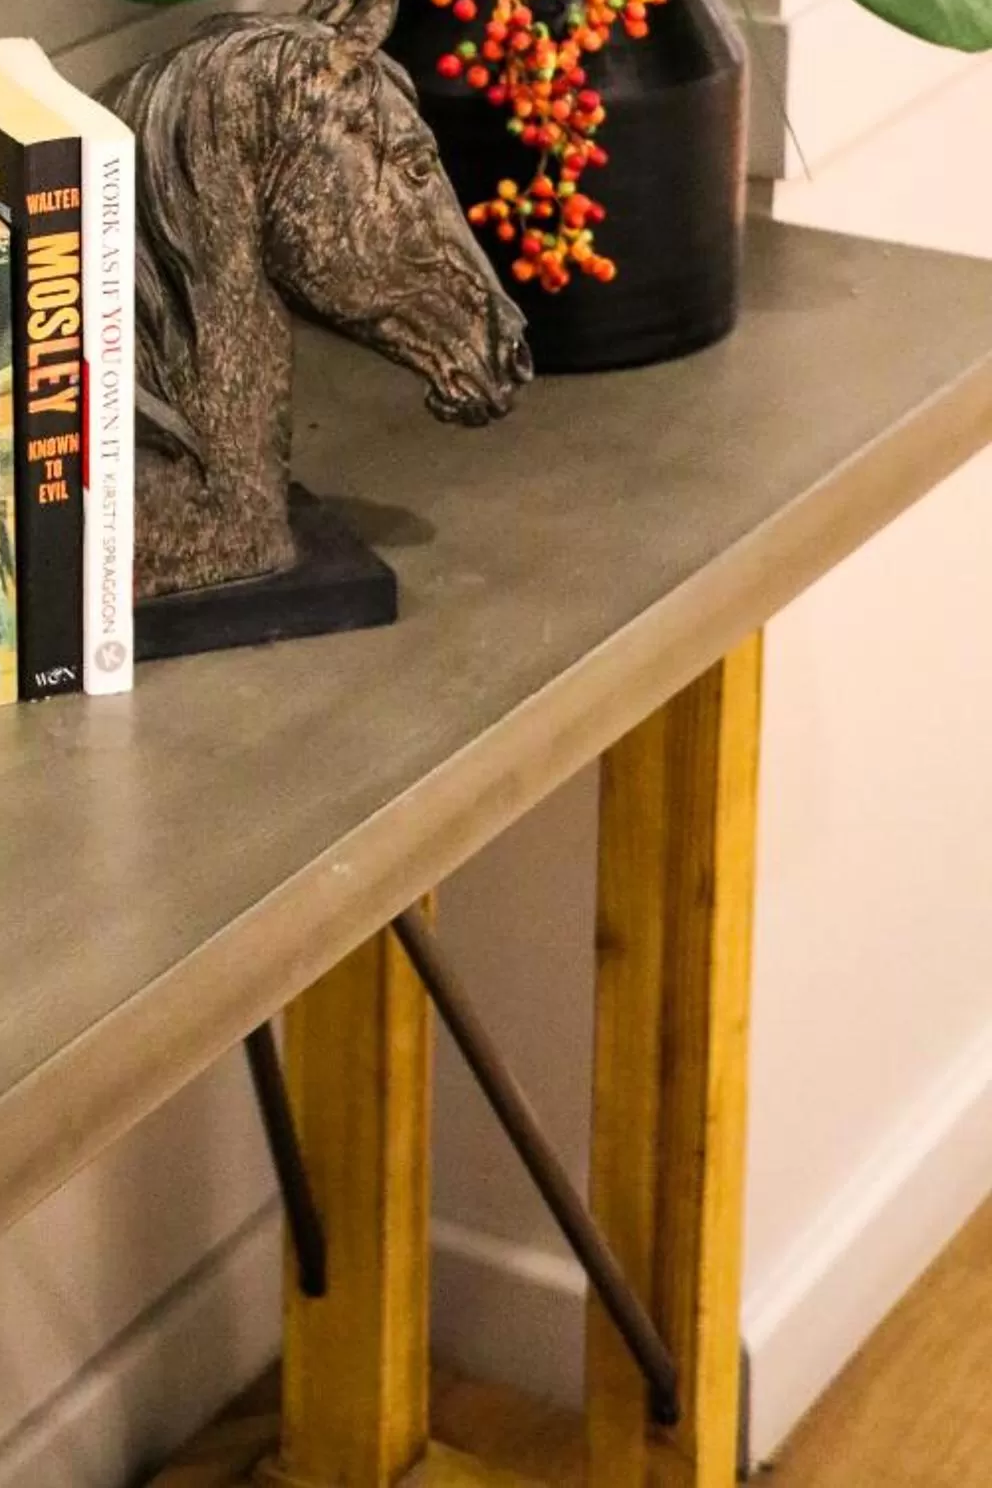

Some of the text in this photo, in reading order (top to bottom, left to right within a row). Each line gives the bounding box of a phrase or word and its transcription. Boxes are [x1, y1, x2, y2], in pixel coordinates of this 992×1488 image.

[26, 187, 80, 216] WALTER
[27, 231, 80, 414] MOSLEY
[100, 158, 122, 461] WORK AS IF YOU OWN IT
[27, 432, 80, 462] KNOWN
[44, 459, 64, 480] TO
[38, 479, 70, 505] EVIL
[102, 473, 117, 530] KIRSTY
